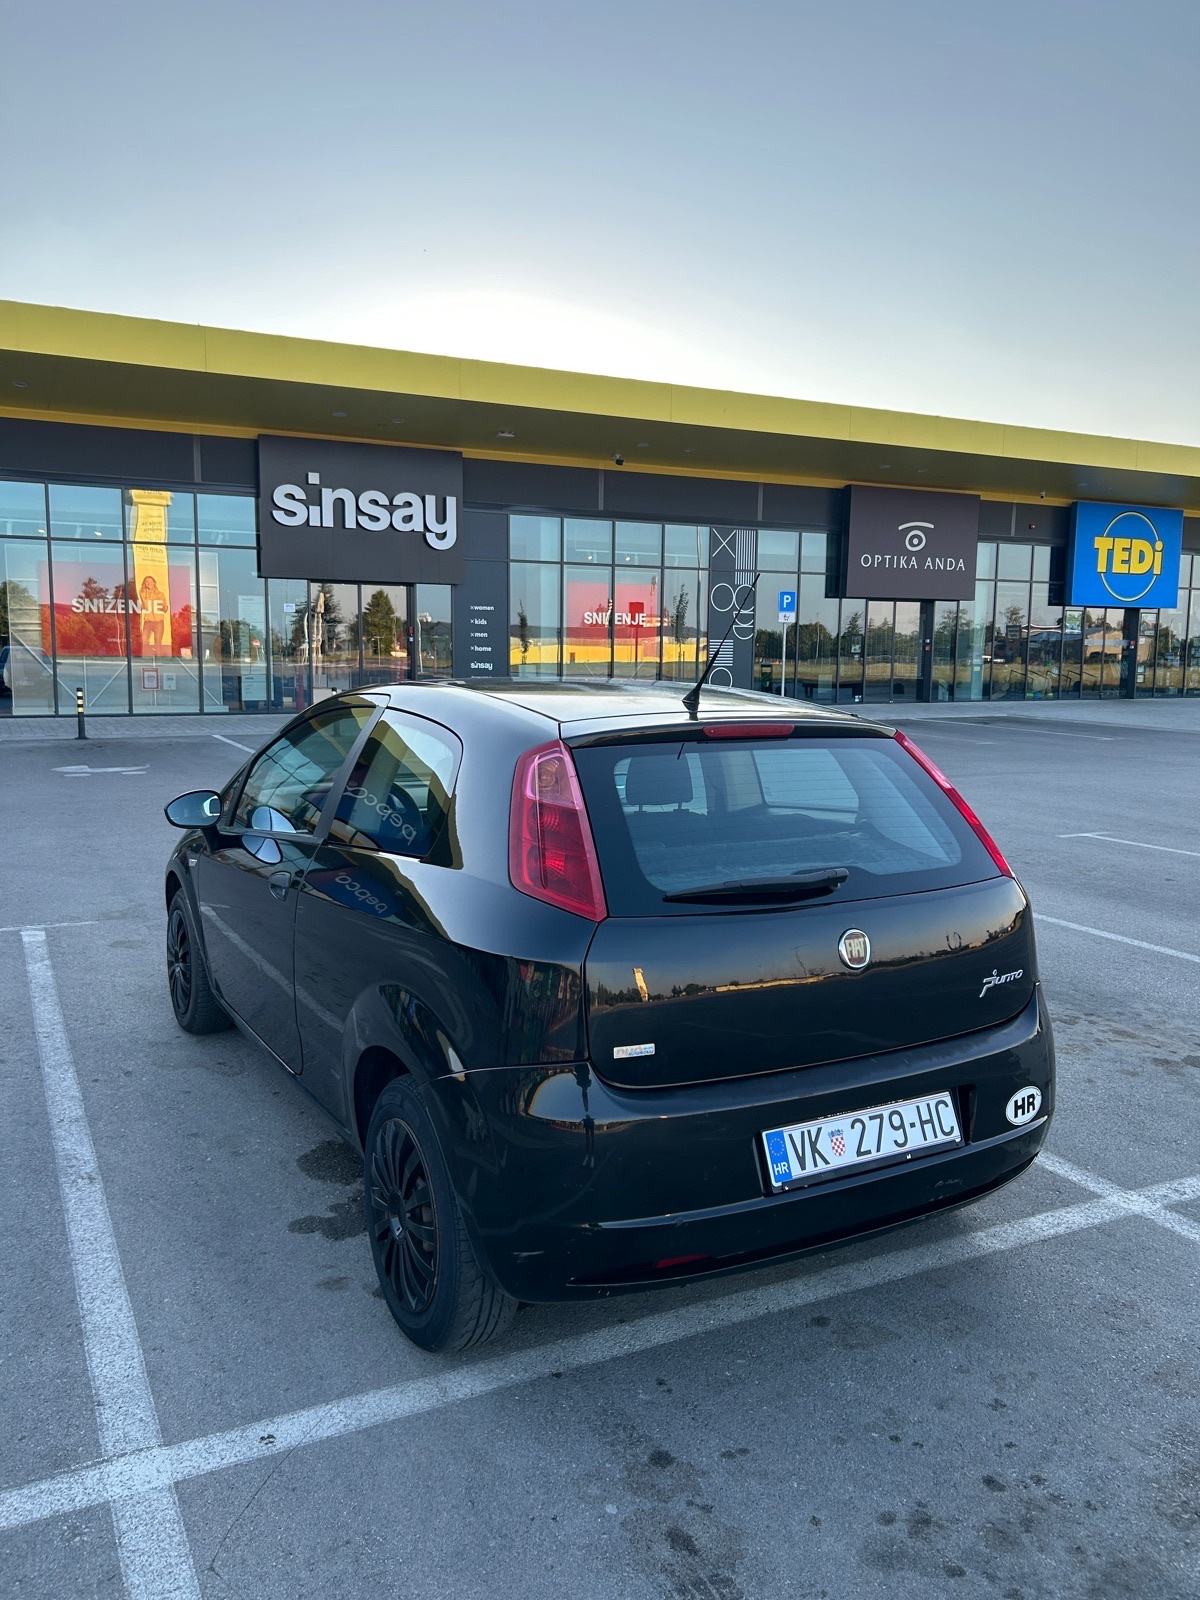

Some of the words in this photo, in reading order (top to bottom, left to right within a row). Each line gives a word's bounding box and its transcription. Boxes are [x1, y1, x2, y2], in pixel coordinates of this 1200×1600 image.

[272, 472, 458, 551] sinsay
[860, 553, 918, 570] OPTIKA
[924, 556, 965, 571] ANDA
[1094, 536, 1164, 576] TEDi
[71, 595, 164, 615] SNIŽENJE
[783, 595, 792, 608] P
[584, 611, 647, 625] SNIENJE
[470, 661, 493, 671] sinsay
[844, 937, 865, 959] FIAT
[1013, 1092, 1036, 1119] HR
[788, 1126, 830, 1171] VK
[850, 1099, 955, 1159] 279-HC
[773, 1161, 789, 1176] HR
